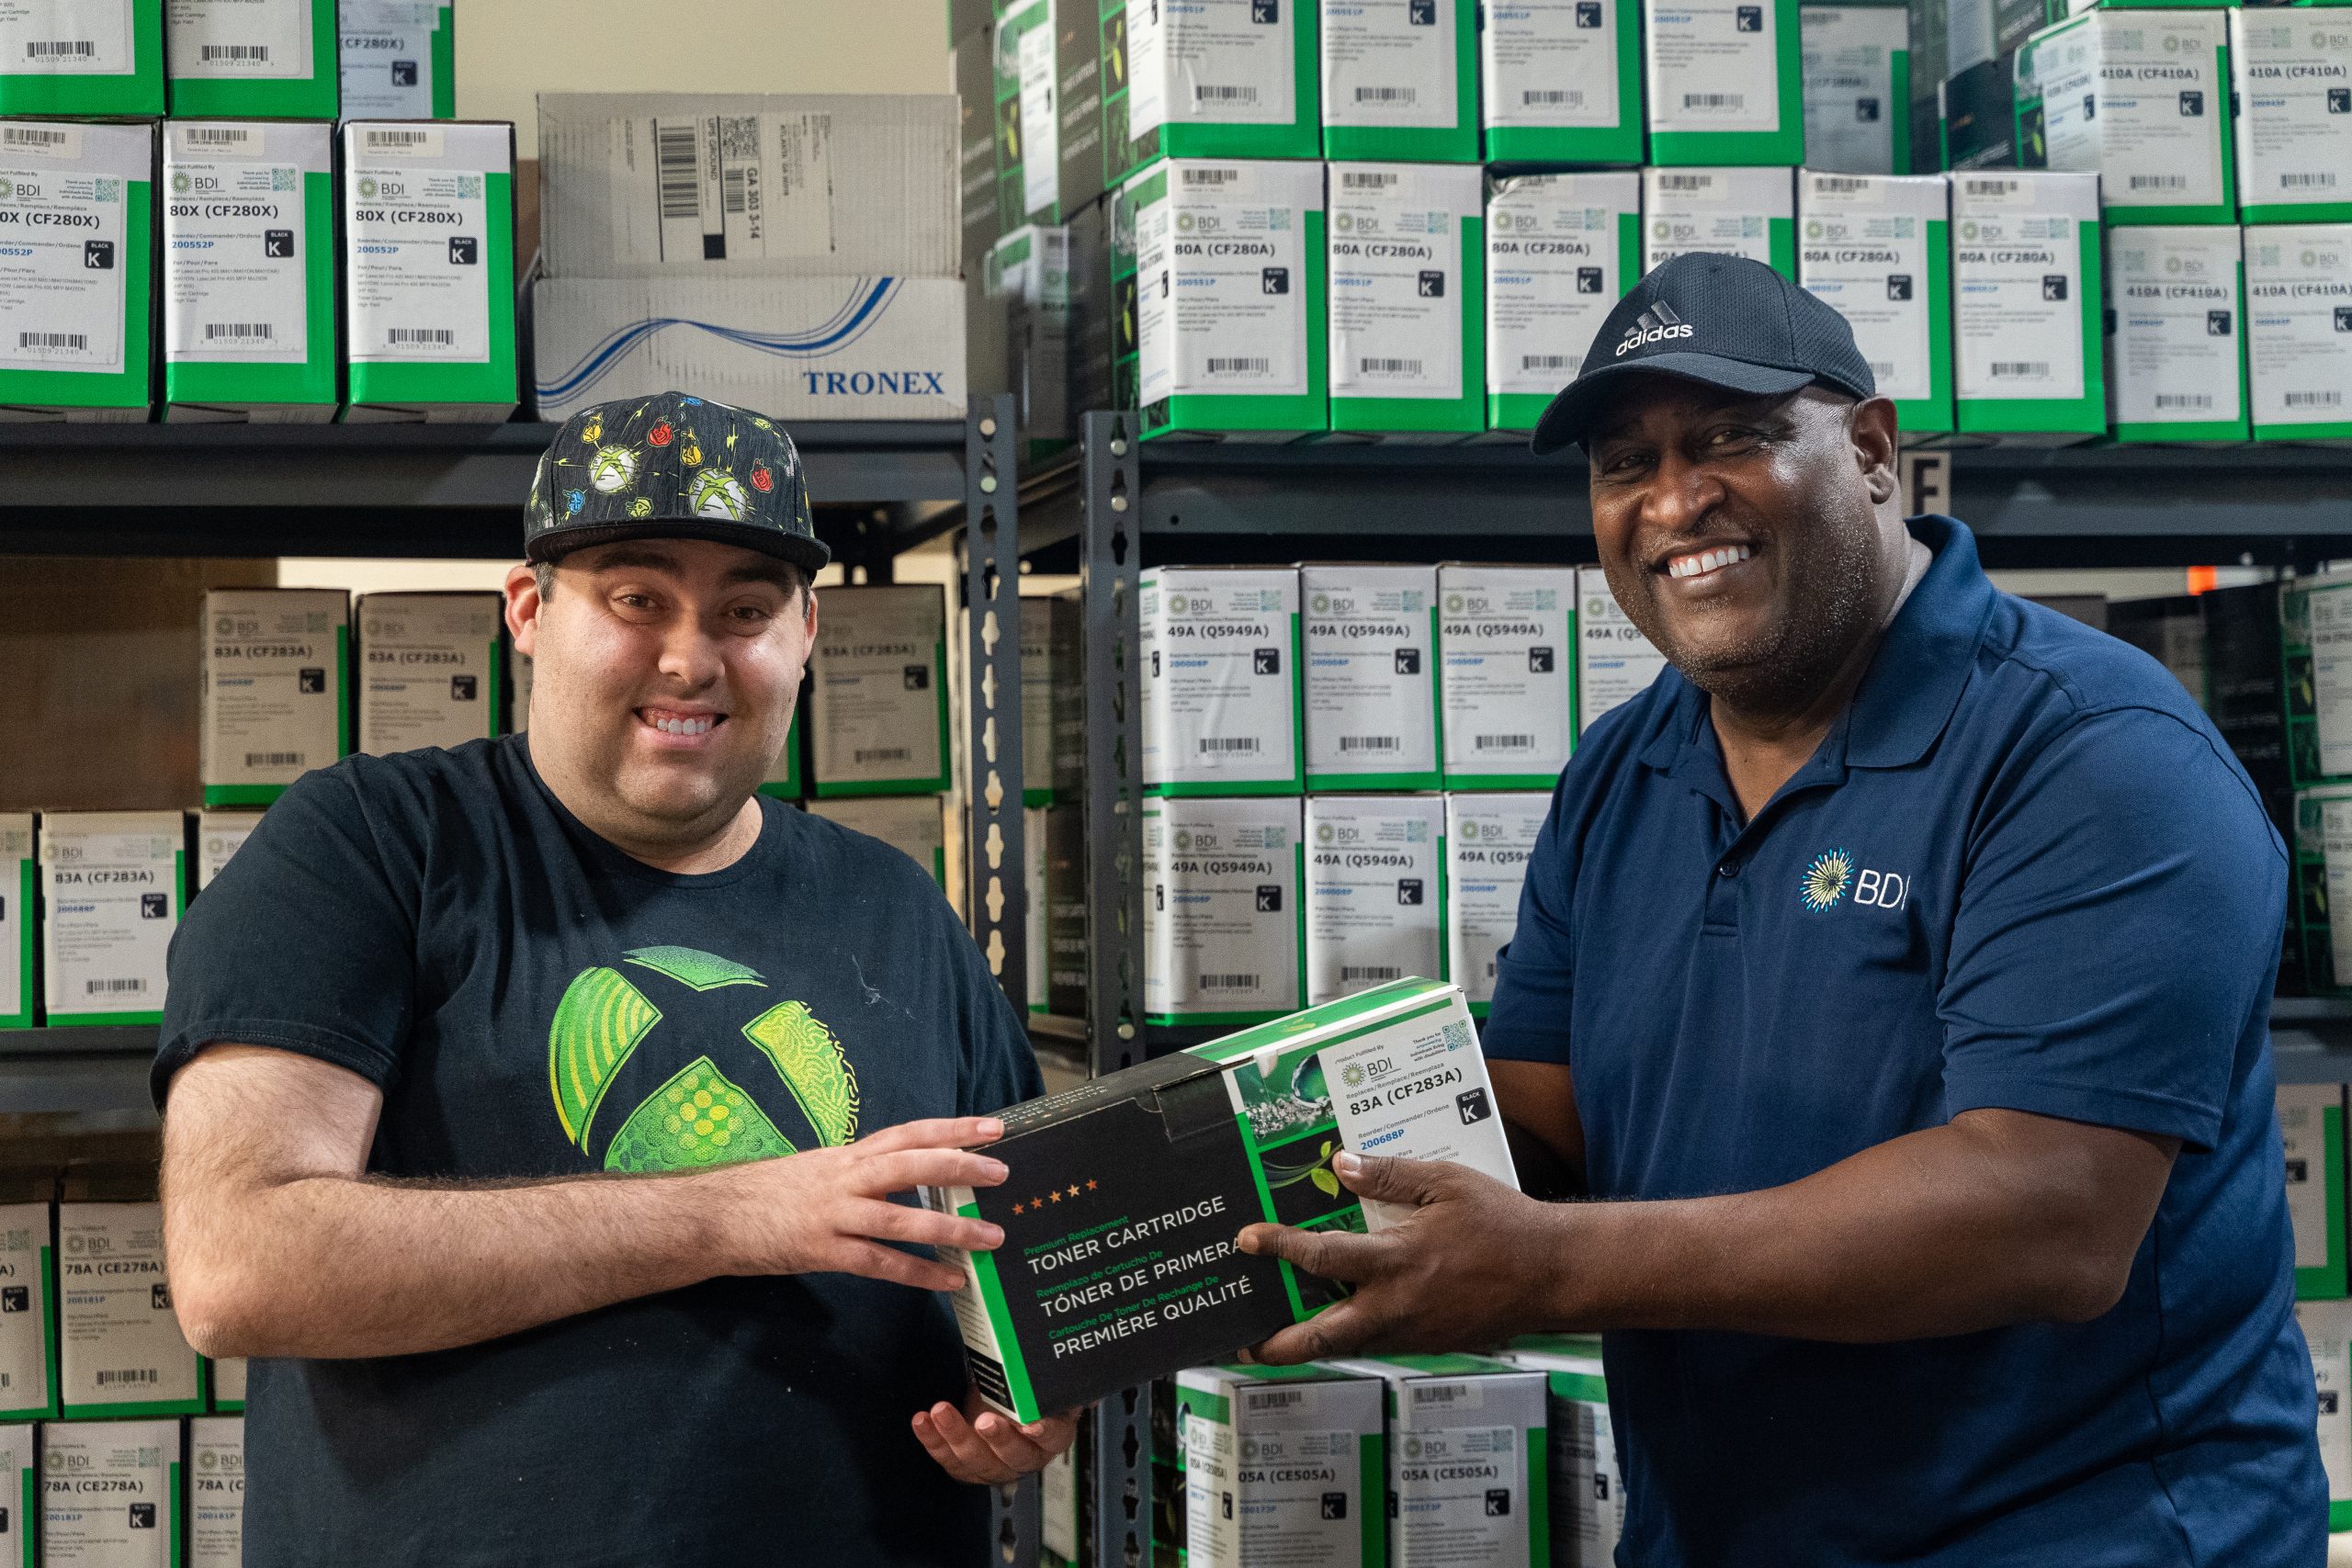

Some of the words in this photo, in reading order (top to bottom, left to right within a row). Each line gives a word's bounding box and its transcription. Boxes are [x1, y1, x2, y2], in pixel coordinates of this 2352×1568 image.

[1255, 7, 1266, 23] K
[1412, 9, 1424, 24] K
[2181, 39, 2201, 49] BDI
[2100, 68, 2133, 79] 410A
[2139, 68, 2199, 81] (CF410A)
[2249, 66, 2280, 78] 410A
[2286, 66, 2346, 80] (CF410A)
[2182, 101, 2194, 114] K
[2330, 97, 2343, 111] K
[709, 140, 718, 181] GROUND
[195, 178, 219, 189] BDI
[746, 167, 758, 187] GA
[17, 184, 40, 197] BDI
[381, 184, 404, 195] BDI
[748, 191, 759, 211] 303
[170, 206, 199, 217] 80X
[206, 206, 279, 219] (CF280X)
[356, 211, 385, 222] 80X
[391, 211, 463, 226] (CF280X)
[26, 212, 100, 230] (CF280X)
[749, 214, 761, 239] 3-14
[1198, 217, 1220, 229] BDI
[1356, 218, 1379, 230] BDI
[172, 241, 214, 249] 200552P
[268, 242, 281, 256] K
[1176, 244, 1202, 255] 80A
[1208, 243, 1275, 257] (CF280A)
[1492, 243, 1520, 254] 80A
[1524, 243, 1590, 257] (CF280A)
[87, 252, 100, 266] K
[452, 249, 464, 263] K
[1333, 244, 1361, 255] 80A
[1365, 244, 1433, 261] (CF280A)
[1804, 252, 1830, 263] 80A
[1836, 252, 1900, 266] (CF280A)
[1959, 252, 1986, 263] 80A
[1991, 252, 2054, 266] (CF280A)
[1264, 277, 1277, 294] K
[1420, 281, 1433, 296] K
[1578, 278, 1591, 294] K
[1889, 285, 1902, 299] K
[2045, 286, 2058, 299] K
[2127, 286, 2161, 298] 410A
[2166, 286, 2228, 299] (CF410A)
[2253, 285, 2287, 297] 410A
[2291, 283, 2352, 298] (CF410A)
[2209, 318, 2222, 334] K
[1615, 323, 1694, 356] adidas
[803, 371, 944, 395] TRONEX
[1191, 599, 1213, 612] BDI
[1332, 599, 1355, 611] BDI
[1466, 598, 1488, 610] BDI
[1168, 625, 1195, 637] 49A
[1200, 625, 1270, 639] (Q5949A)
[1309, 625, 1337, 637] 49A
[1341, 625, 1410, 639] (Q5949A)
[1444, 625, 1472, 636] 49A
[1476, 625, 1544, 637] (Q5949A)
[1586, 628, 1613, 639] 49A
[1256, 660, 1268, 674] K
[1396, 658, 1409, 672] K
[1531, 657, 1544, 672] K
[1338, 829, 1360, 840] BDI
[1481, 825, 1503, 837] BDI
[1194, 836, 1217, 847] BDI
[62, 847, 83, 859] BDI
[1459, 852, 1486, 863] 49A
[1170, 862, 1199, 873] 49A
[1204, 862, 1272, 875] (Q5949A)
[1314, 854, 1341, 866] 49A
[1346, 854, 1415, 869] (Q5949A)
[55, 873, 83, 884] 83A
[88, 871, 154, 886] (CF283A)
[1400, 889, 1412, 904] K
[1854, 869, 1911, 911] BDI
[143, 904, 156, 918] K
[1259, 897, 1271, 911] K
[1355, 1047, 1376, 1058] Fulfilled
[1409, 1047, 1433, 1057] individuals
[1424, 1049, 1446, 1058] disabilities
[1367, 1056, 1393, 1077] BDI
[1346, 1062, 1444, 1100] Replaces/Remplace/Reemplaza
[1351, 1096, 1384, 1115] 83A
[1387, 1067, 1463, 1106] (CF283A)
[1463, 1091, 1481, 1101] BLACK
[1463, 1104, 1478, 1122] K
[1358, 1104, 1450, 1139] Reorder/Commander/Ordene
[1360, 1128, 1406, 1150] 200688P
[1023, 1236, 1067, 1257] Premium
[1068, 1215, 1129, 1242] Replacement
[1027, 1240, 1101, 1275] TONER
[1106, 1196, 1226, 1247] CARTRIDGE
[88, 1238, 110, 1250] BDI
[66, 1262, 92, 1275] 78A
[97, 1260, 165, 1277] (CE278A)
[1035, 1276, 1090, 1299] Reemplazo
[1104, 1256, 1148, 1275] Cartucho
[1148, 1249, 1163, 1260] De
[1040, 1282, 1114, 1317] TÓNER
[1119, 1269, 1149, 1292] DE
[5, 1297, 17, 1310] K
[1047, 1316, 1097, 1339] Cartouche
[1099, 1312, 1114, 1323] De
[1114, 1303, 1141, 1317] Toner
[1142, 1297, 1156, 1308] De
[1158, 1281, 1204, 1303] Rechange
[1204, 1275, 1219, 1286] De
[1053, 1311, 1159, 1359] PREMIÈRE
[1163, 1275, 1253, 1321] QUALITÉ
[1261, 1444, 1284, 1457] BDI
[1424, 1440, 1447, 1454] BDI
[67, 1455, 89, 1468] BDI
[1238, 1470, 1265, 1483] 05A
[1270, 1469, 1336, 1485] (CE505A)
[1402, 1468, 1430, 1481] 05A
[1433, 1466, 1499, 1483] (CE505A)
[46, 1480, 71, 1492] 78A
[75, 1480, 143, 1495] (CE278A)
[197, 1479, 224, 1491] 78A
[1323, 1504, 1336, 1519] K
[1487, 1499, 1499, 1516] K
[132, 1514, 143, 1527] K
